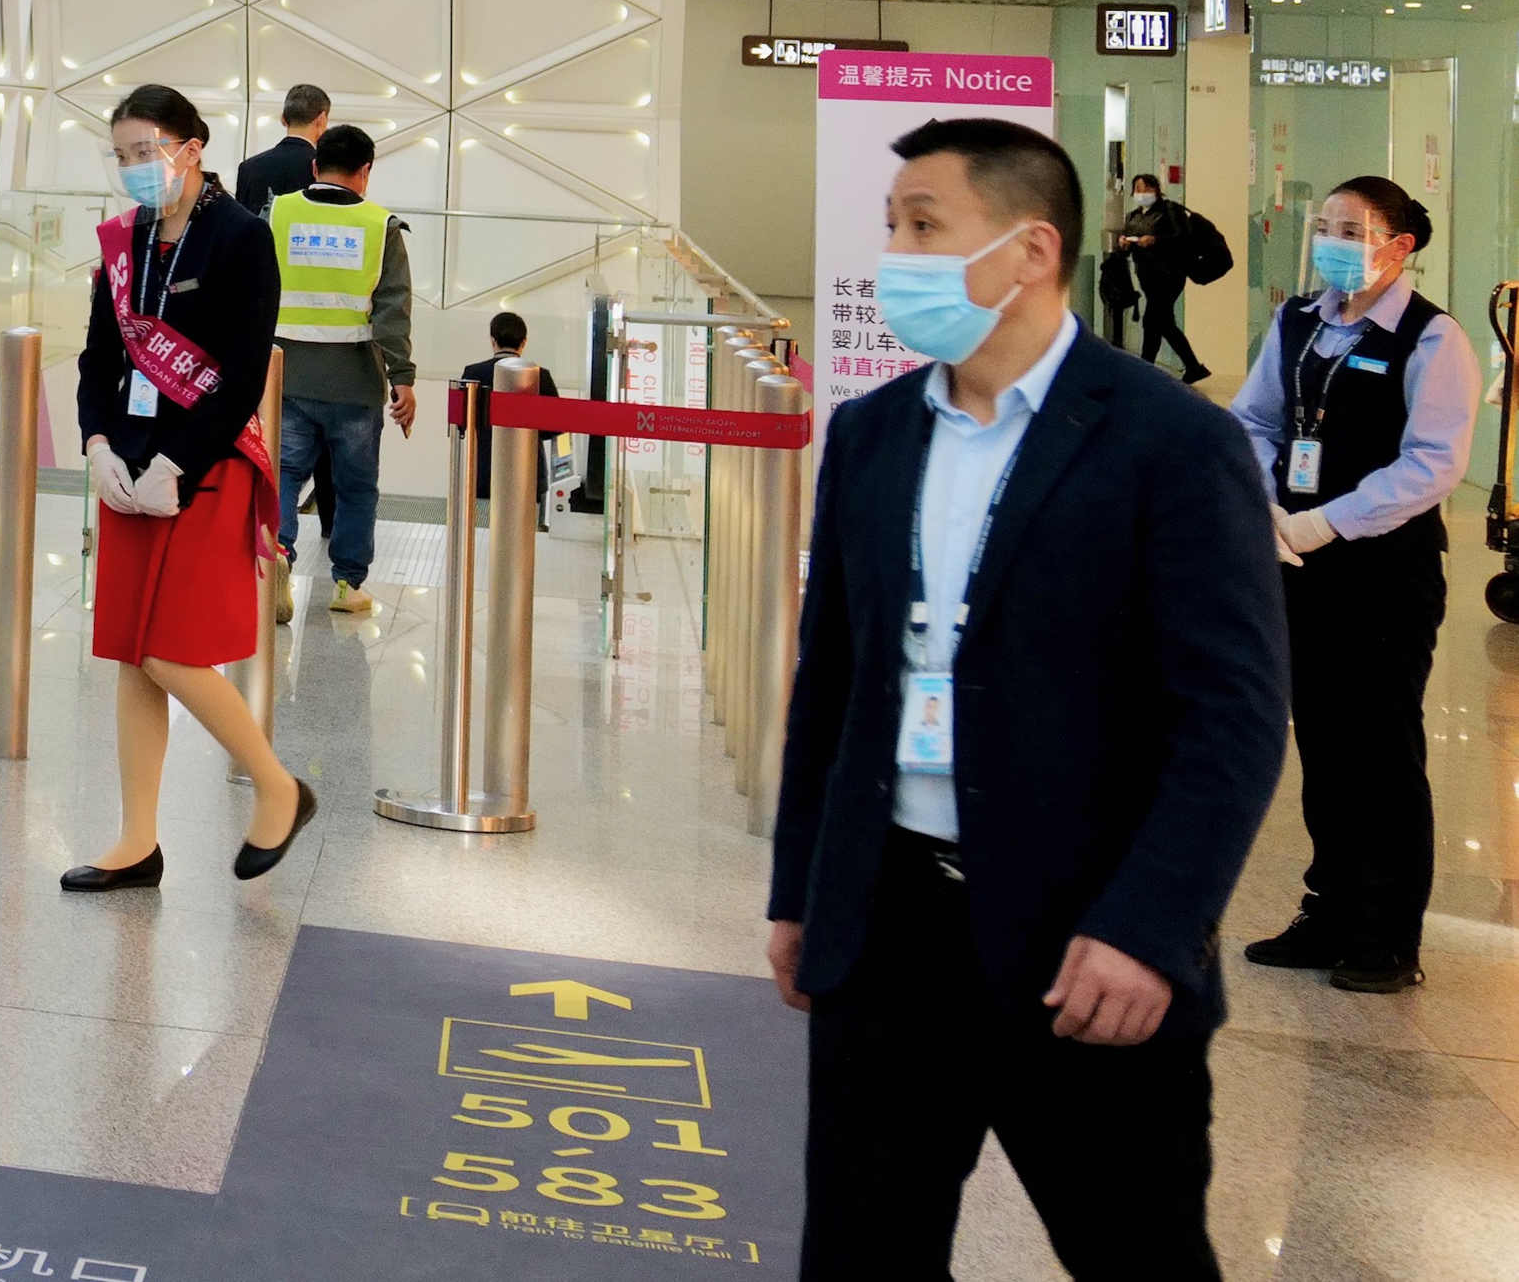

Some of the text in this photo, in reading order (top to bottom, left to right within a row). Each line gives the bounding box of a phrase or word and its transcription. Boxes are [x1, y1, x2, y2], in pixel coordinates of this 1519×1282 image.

[838, 64, 932, 88] 温馨提示
[945, 67, 1033, 92] Notice
[833, 277, 876, 298] 长者
[832, 303, 885, 325] 带较
[830, 385, 850, 396] We
[450, 1092, 728, 1156] 501
[432, 1151, 728, 1221] 583
[499, 1210, 725, 1251] 前往卫星厅
